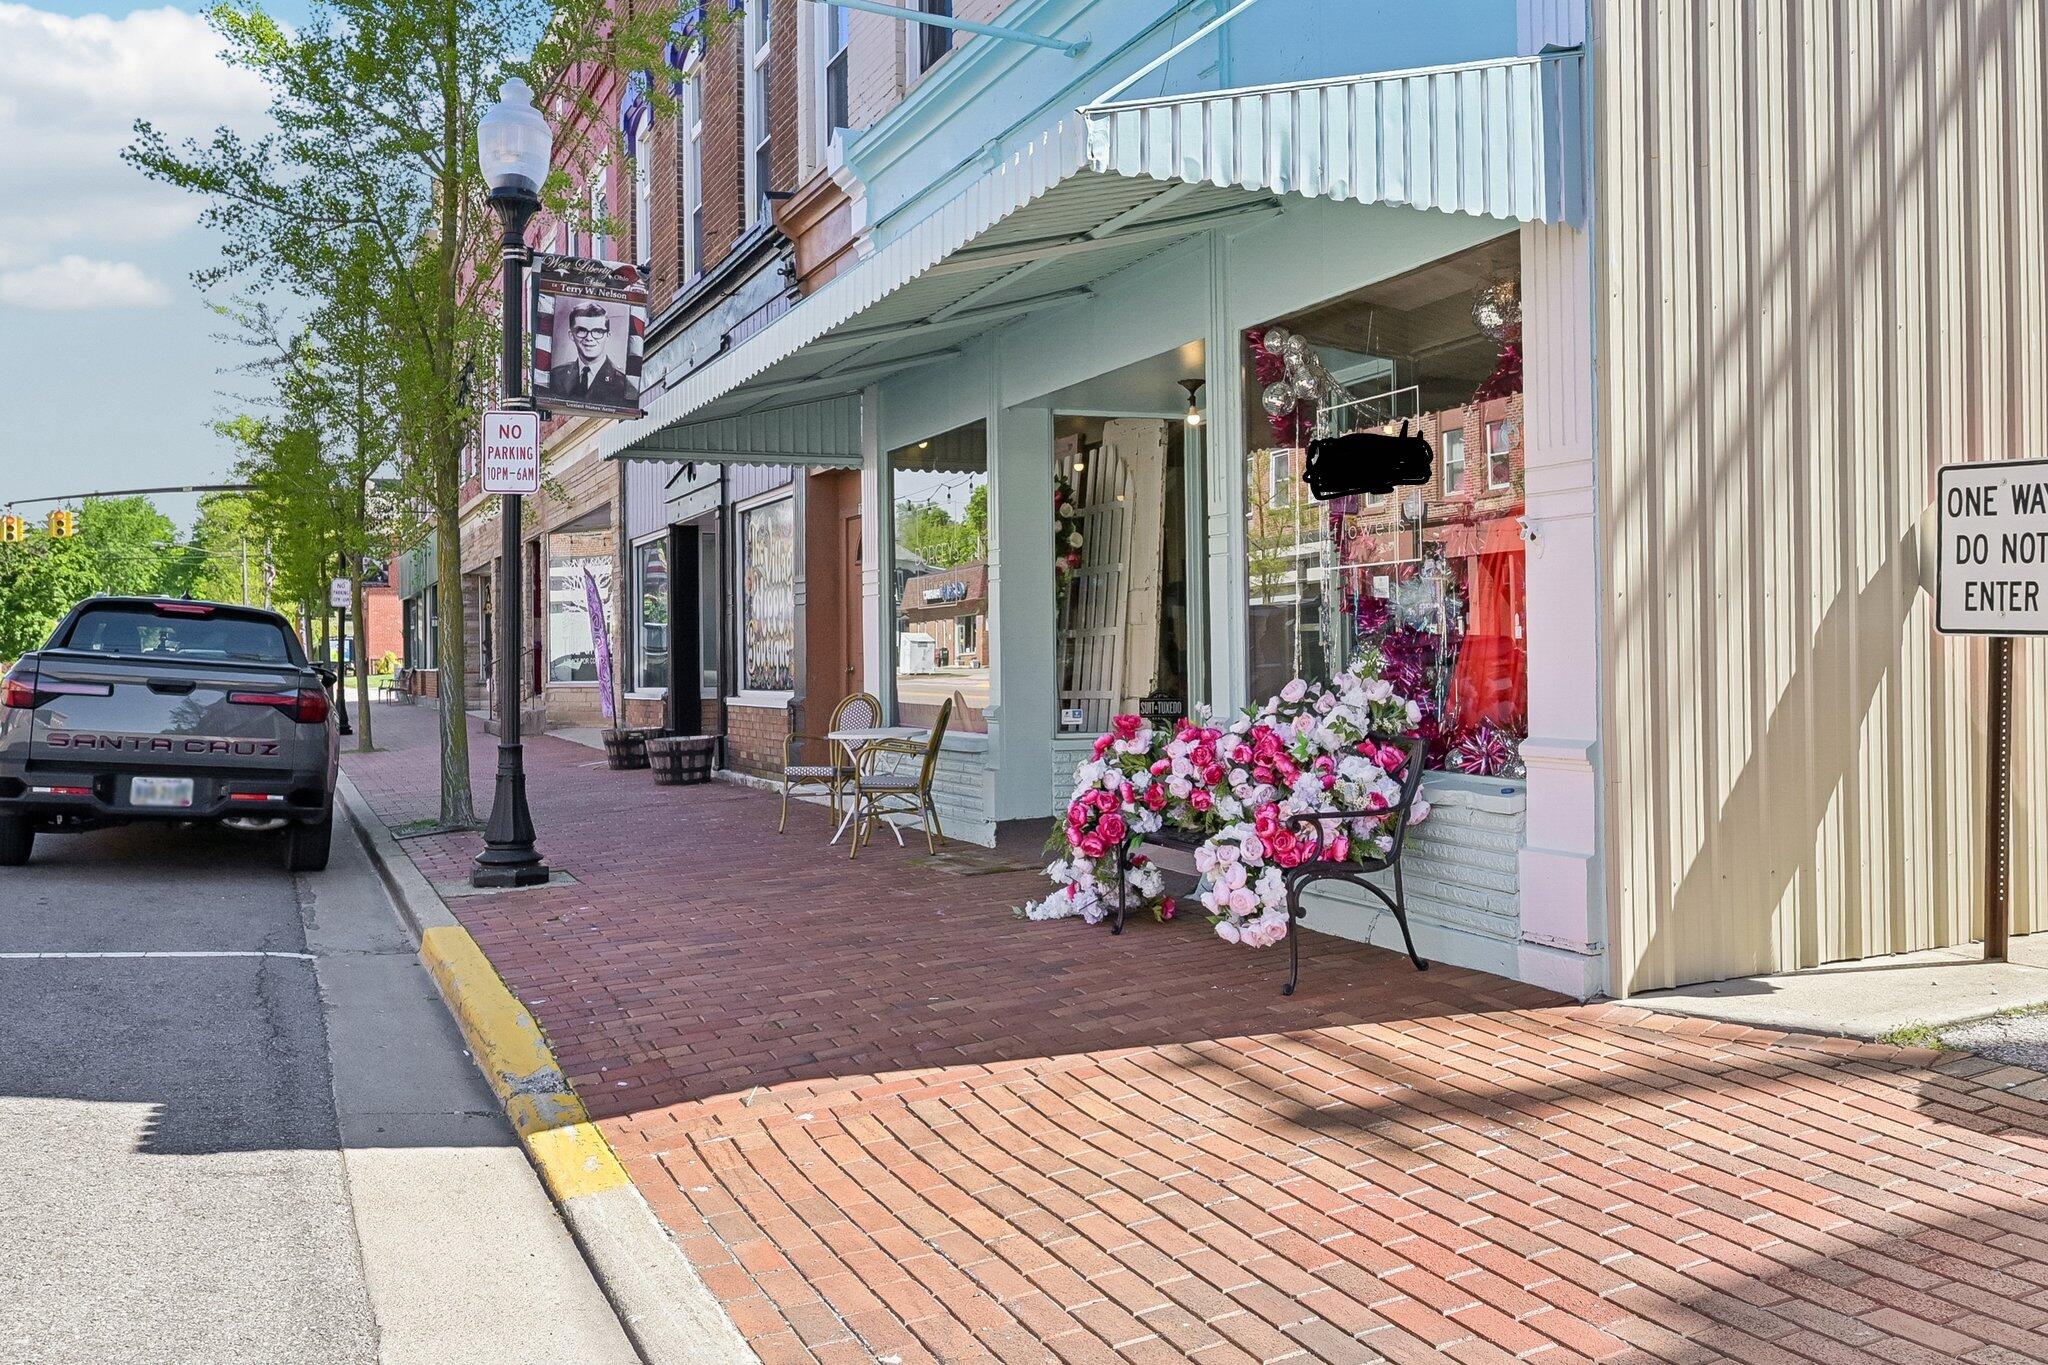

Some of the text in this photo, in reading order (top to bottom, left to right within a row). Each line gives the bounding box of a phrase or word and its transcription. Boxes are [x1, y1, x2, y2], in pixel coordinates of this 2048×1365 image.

[541, 255, 571, 269] West
[560, 283, 582, 295] Terry
[585, 287, 597, 296] W.
[598, 289, 627, 300] Nelson
[499, 424, 522, 439] NO
[487, 446, 533, 460] PARKING
[1947, 485, 1998, 518] ONE
[749, 516, 793, 593] The Villag
[1956, 531, 2048, 565] DO NOT
[1965, 581, 2039, 612] ENTER
[747, 620, 790, 682] Boutique
[1140, 701, 1155, 715] SUIT
[1158, 701, 1182, 714] TUXEDO
[46, 732, 280, 757] SANTA CRUZ
